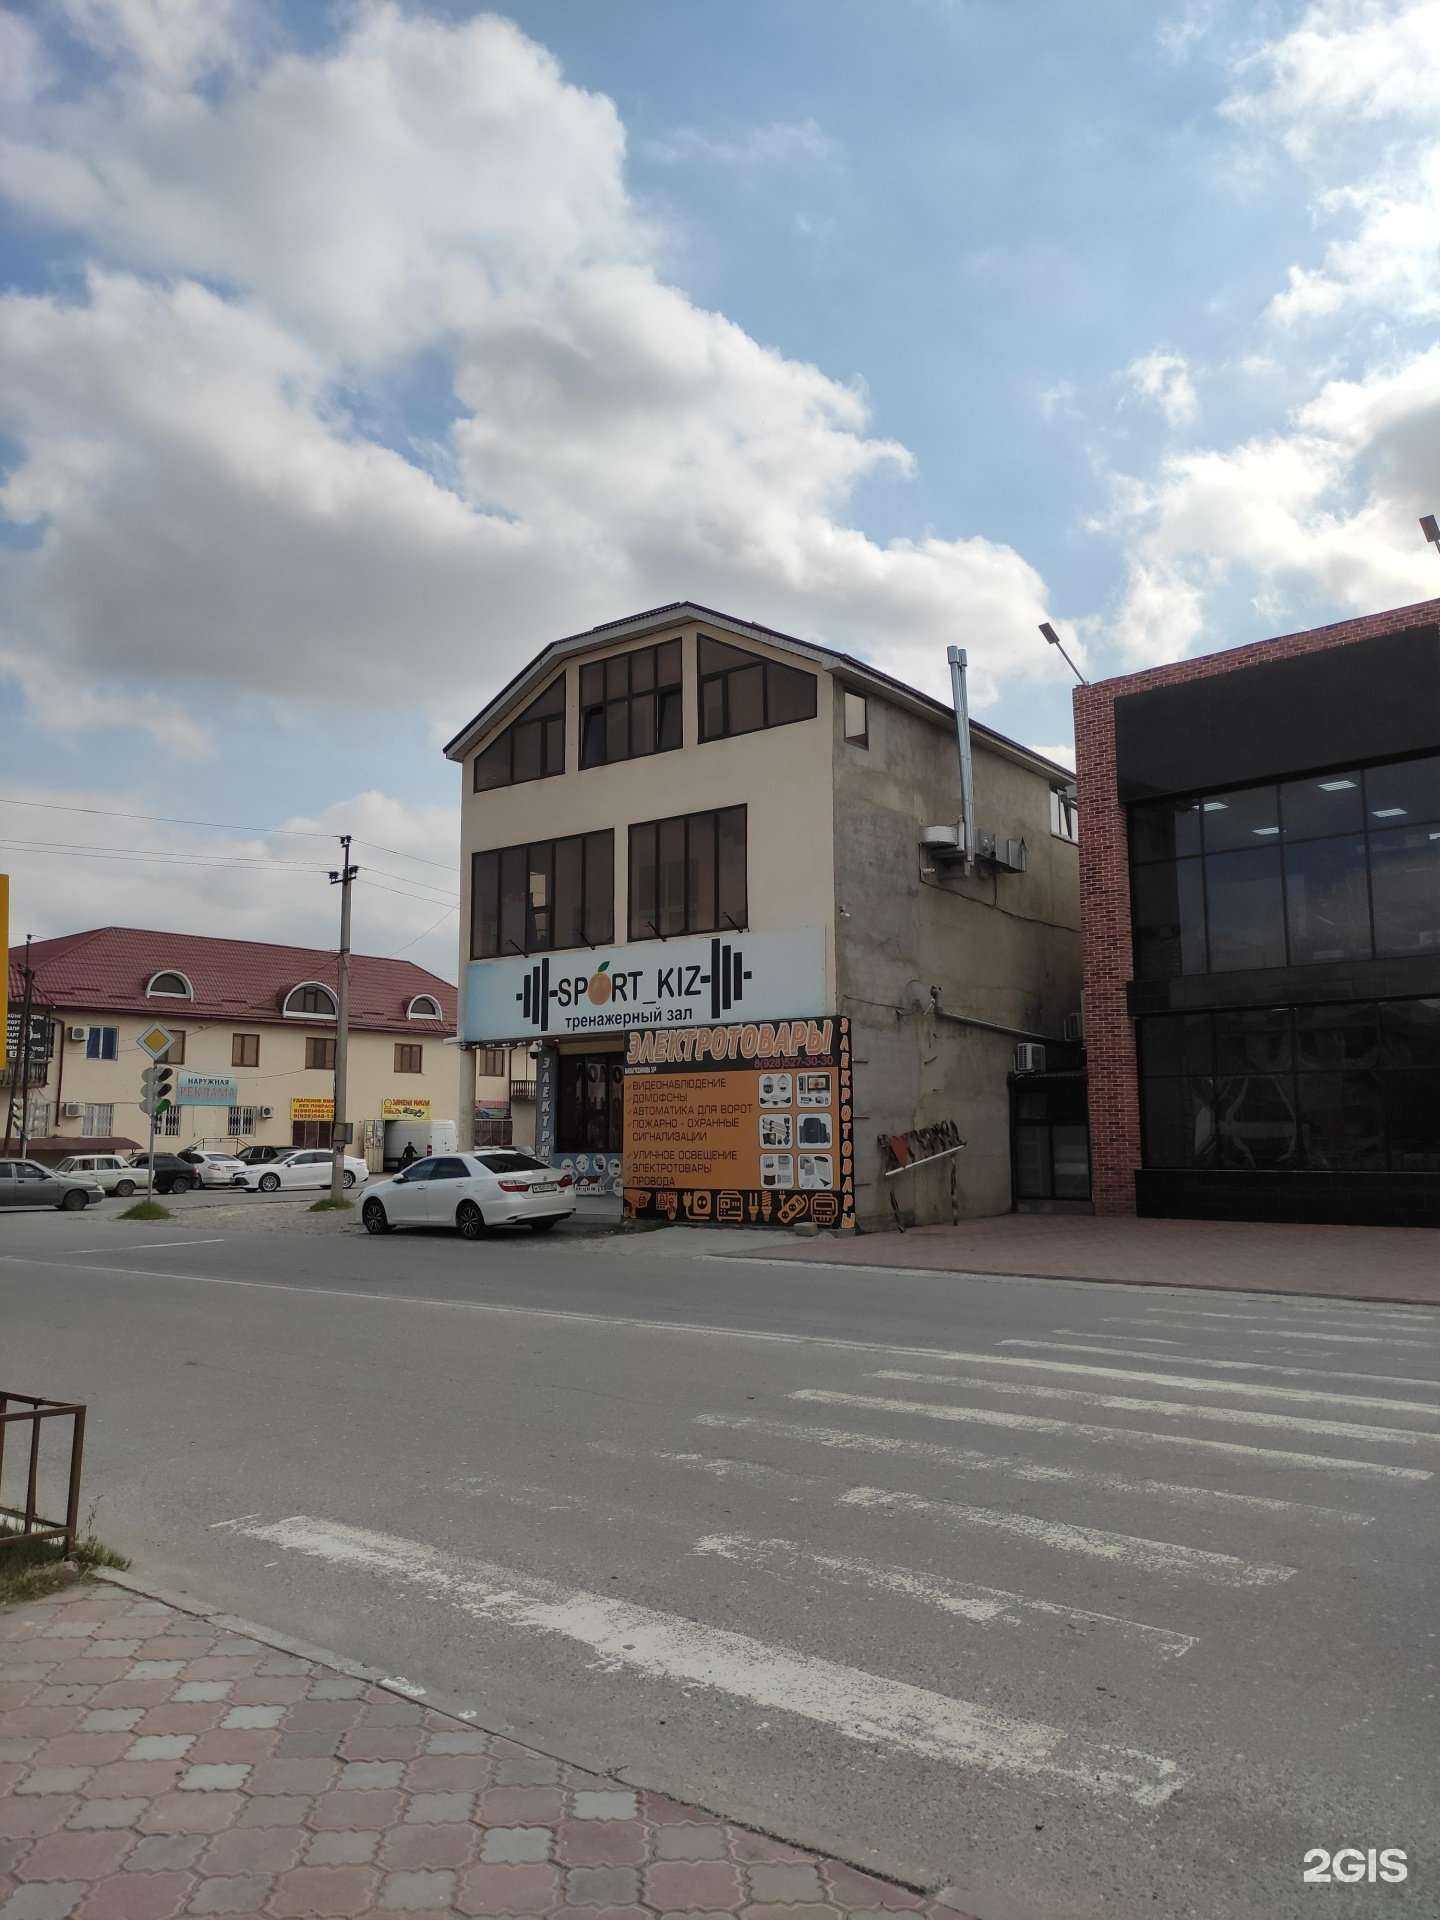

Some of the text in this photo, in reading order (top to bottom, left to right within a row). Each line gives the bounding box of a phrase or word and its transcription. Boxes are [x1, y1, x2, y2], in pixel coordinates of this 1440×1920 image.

[565, 1007, 692, 1031] тренажерный зал
[627, 1020, 833, 1063] ЭЛЕКТРОТОВАРЫ
[187, 1078, 230, 1086] НАРУЖНАЯ
[632, 1078, 727, 1091] ВИДЕОНАБЛЮДЕНИЕ
[632, 1093, 688, 1104] ДОМОФОНЫ
[632, 1104, 753, 1116] АВТОМАТИКА ДЛЯ ВОРОТ
[632, 1119, 677, 1129] ПОЖАРНО
[687, 1117, 739, 1128] ОХРАННЫЕ
[632, 1132, 707, 1143] СИГНАЛИЗАЦИИ
[632, 1150, 737, 1160] УЛИЧНОЕ ОСВЕЩЕНИЕ
[632, 1163, 712, 1173] ЭЛЕКТРОТОВАРЫ
[632, 1175, 675, 1186] ПРОВОДА
